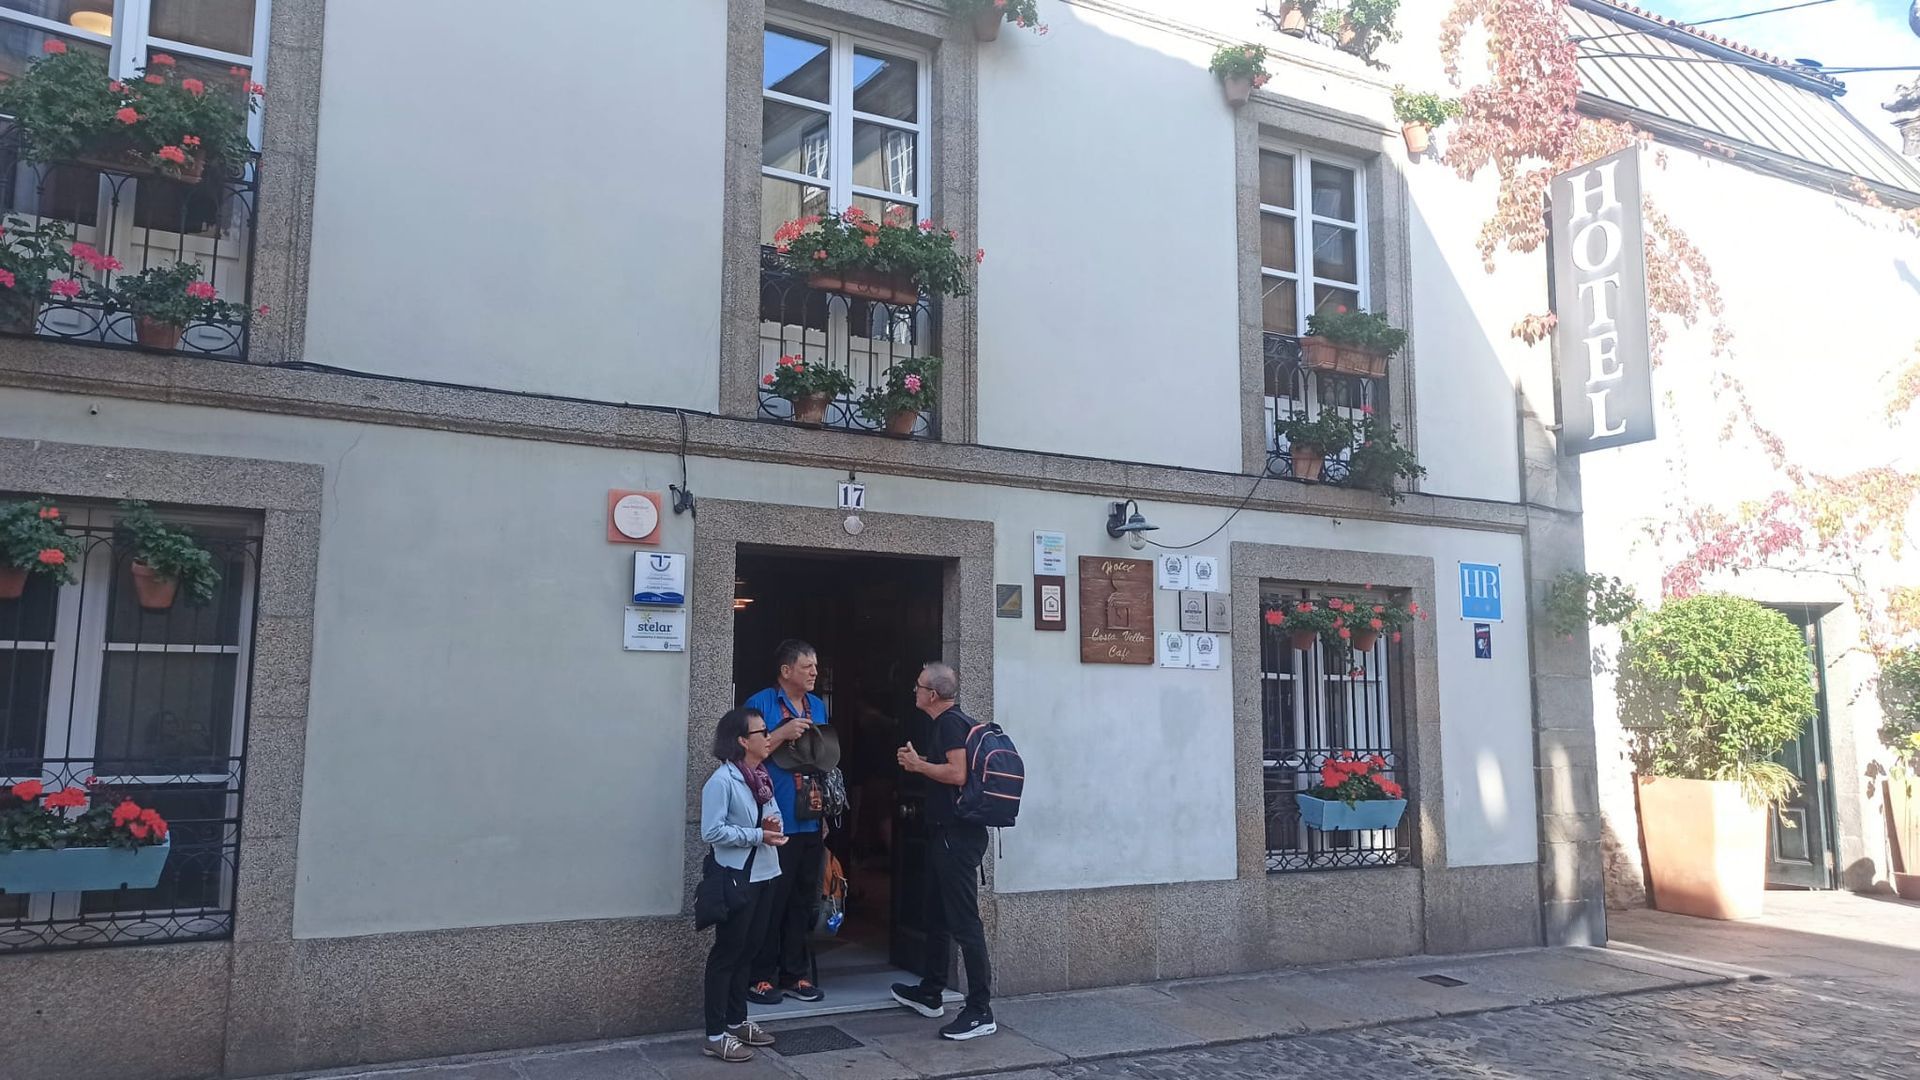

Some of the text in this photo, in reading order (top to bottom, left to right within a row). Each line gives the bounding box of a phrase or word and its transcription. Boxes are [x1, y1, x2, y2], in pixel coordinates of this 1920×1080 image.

[1567, 159, 1626, 440] HOTEL
[843, 486, 864, 506] 17
[1102, 561, 1135, 575] Hotel
[1463, 569, 1498, 599] HR
[638, 622, 673, 632] stelar
[1122, 631, 1145, 642] Vella
